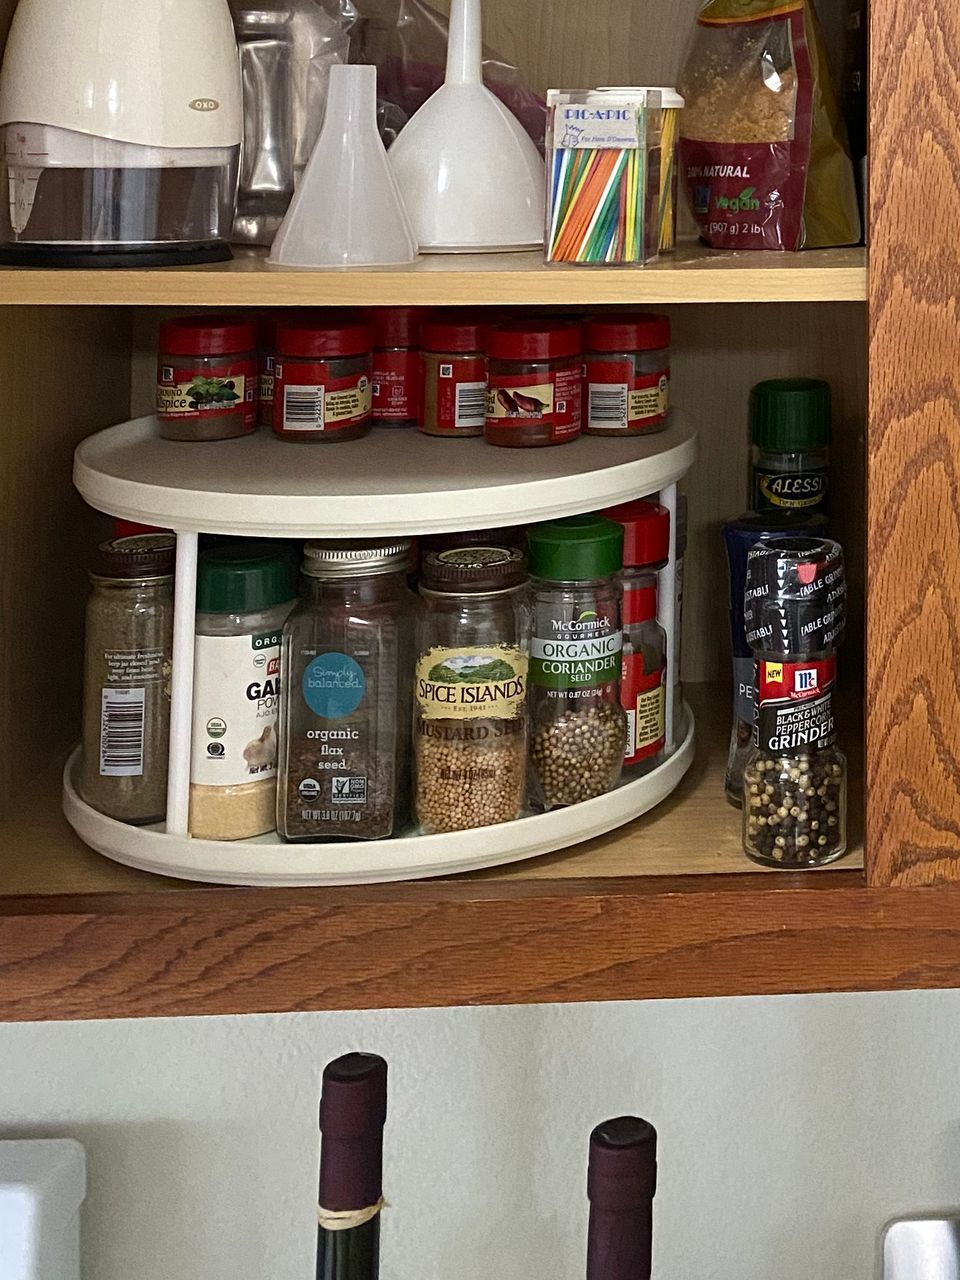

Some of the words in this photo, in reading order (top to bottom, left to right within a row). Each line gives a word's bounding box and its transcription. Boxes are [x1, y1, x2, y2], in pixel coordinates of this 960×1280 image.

[195, 101, 214, 109] OXO
[564, 109, 631, 121] PIC-A-PIC
[704, 165, 750, 178] NATURAL
[715, 194, 760, 214] vegan
[709, 222, 728, 234] (907
[730, 222, 739, 235] g)
[742, 222, 749, 232] 2
[750, 222, 761, 234] lb
[772, 477, 822, 494] ALESSI
[552, 616, 611, 632] McCormick
[254, 636, 282, 647] ORG
[557, 632, 606, 640] GOURMET
[543, 638, 615, 658] ORGANIC
[542, 656, 616, 674] CORIANDER
[570, 673, 592, 682] SEED
[767, 668, 782, 679] NEW
[420, 678, 456, 703] SPICE
[460, 676, 524, 704] ISLANDS
[547, 690, 557, 698] NET
[582, 690, 590, 698] OZ
[418, 719, 490, 741] MUSTARD
[776, 711, 831, 736] PEPPERCORN
[306, 728, 360, 742] organic
[768, 716, 834, 750] GRINDER
[320, 744, 344, 756] flax
[318, 758, 347, 770] seed
